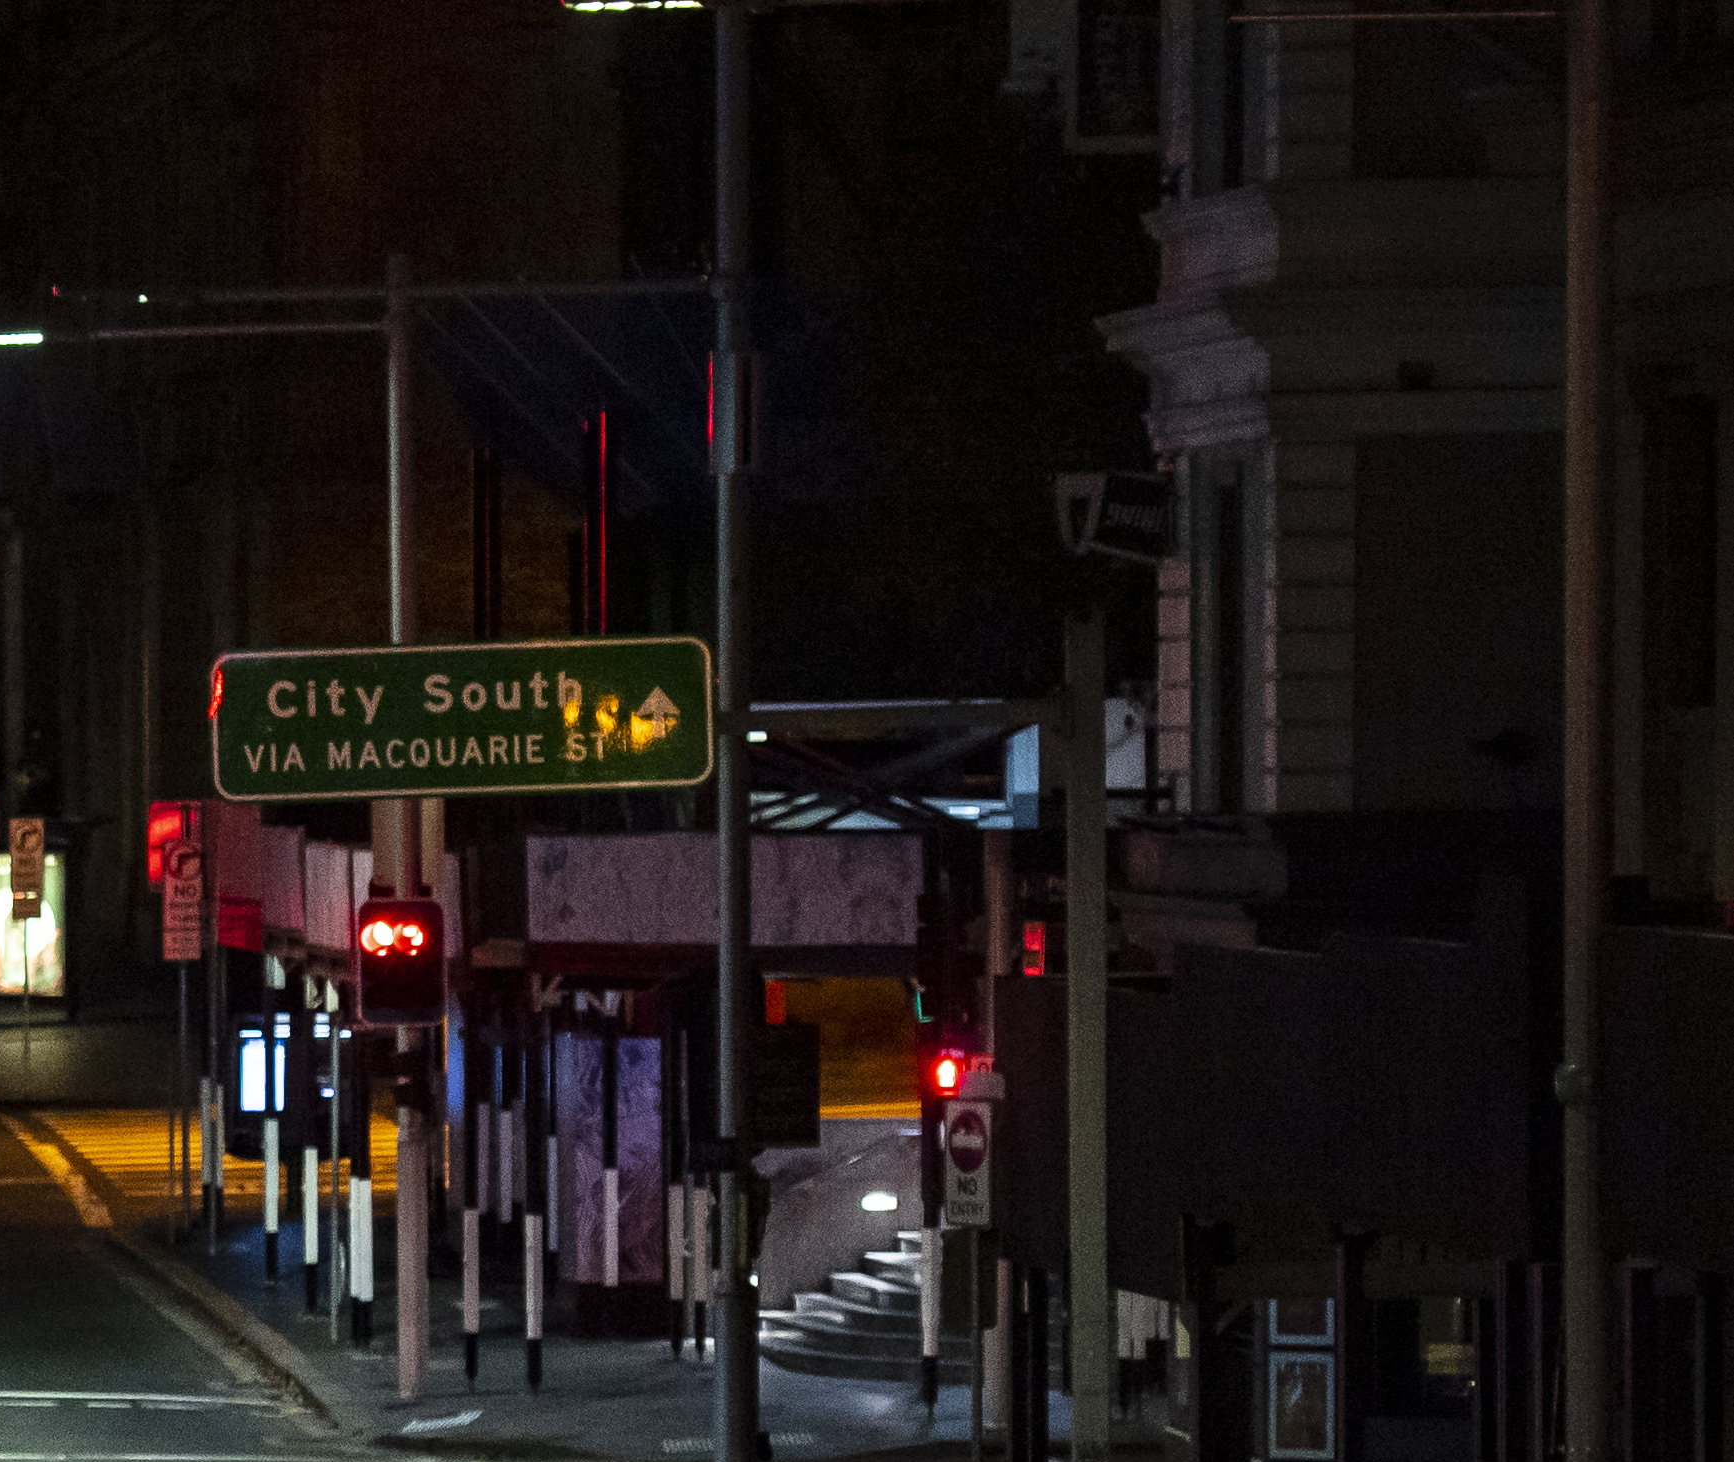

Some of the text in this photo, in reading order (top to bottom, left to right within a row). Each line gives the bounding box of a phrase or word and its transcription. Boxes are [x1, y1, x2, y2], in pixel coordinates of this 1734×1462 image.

[267, 670, 583, 725] City South
[243, 730, 609, 773] VIA MACQUARIE ST
[174, 885, 197, 898] NO
[957, 1175, 978, 1196] NO
[950, 1200, 984, 1216] ENTRY
